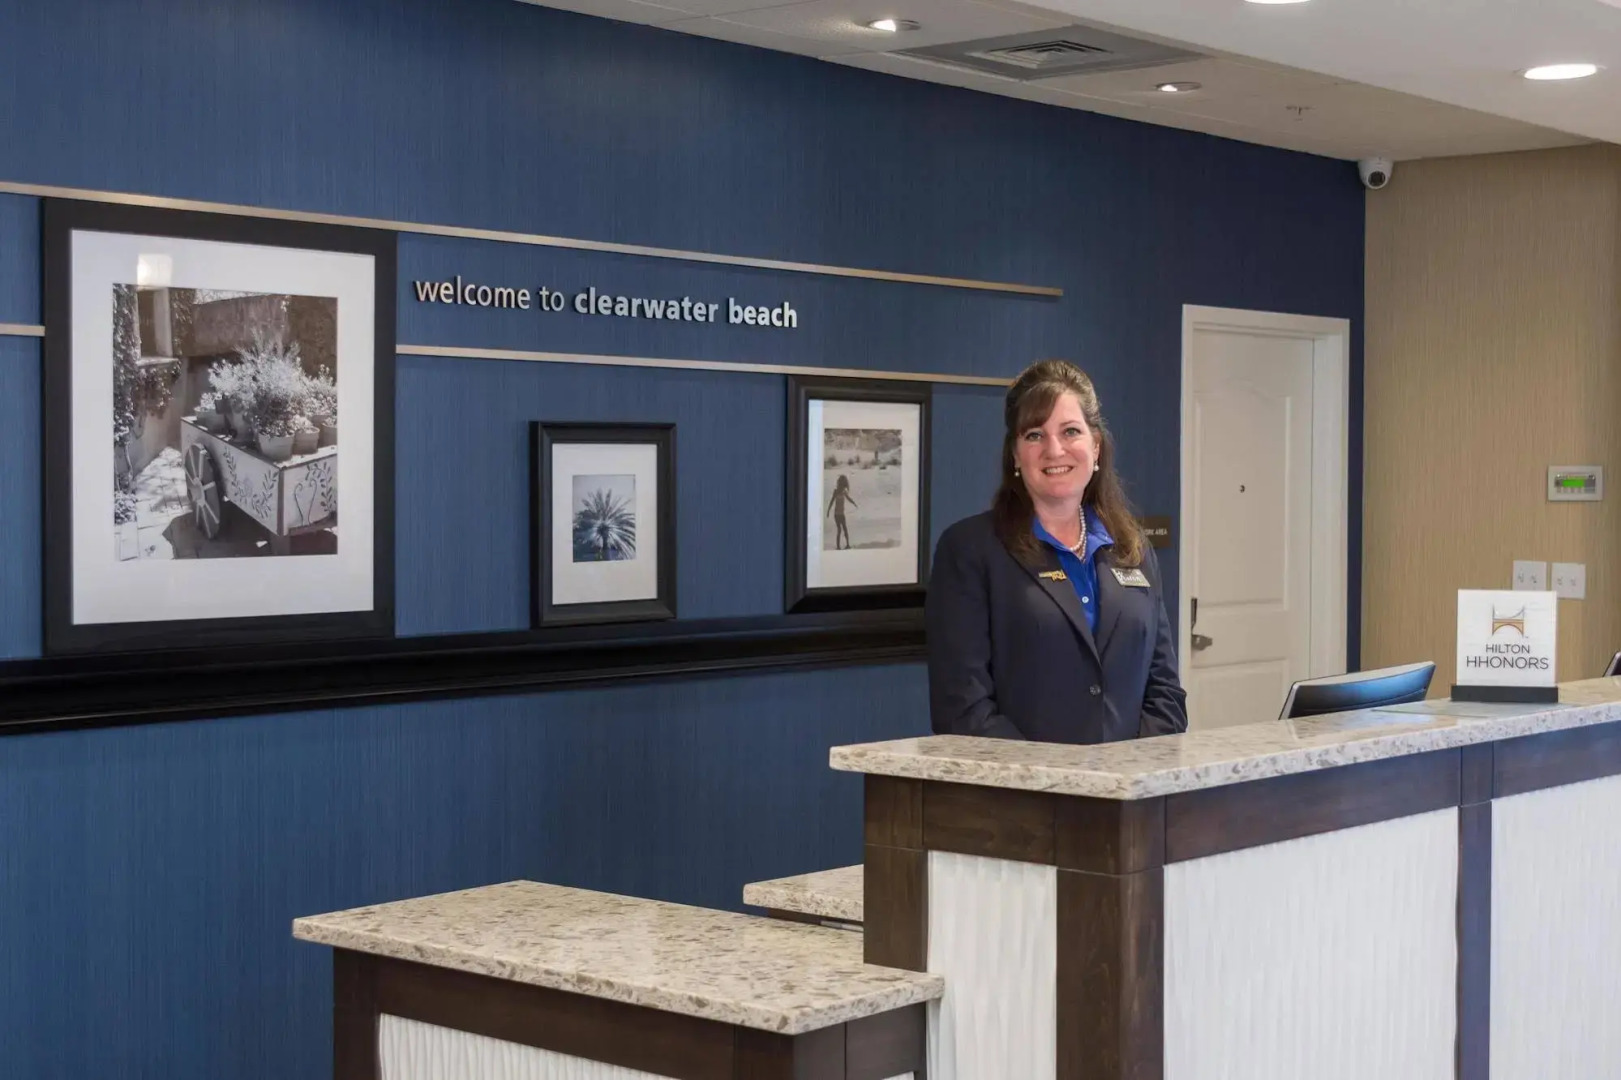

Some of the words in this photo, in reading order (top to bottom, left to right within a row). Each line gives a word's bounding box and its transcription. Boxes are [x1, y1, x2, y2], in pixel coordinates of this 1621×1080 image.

[414, 275, 531, 310] welcome
[539, 286, 565, 312] to
[574, 286, 719, 323] clearwater
[728, 297, 798, 328] beach
[1485, 643, 1531, 654] HILTON
[1466, 655, 1550, 670] HHONORS
